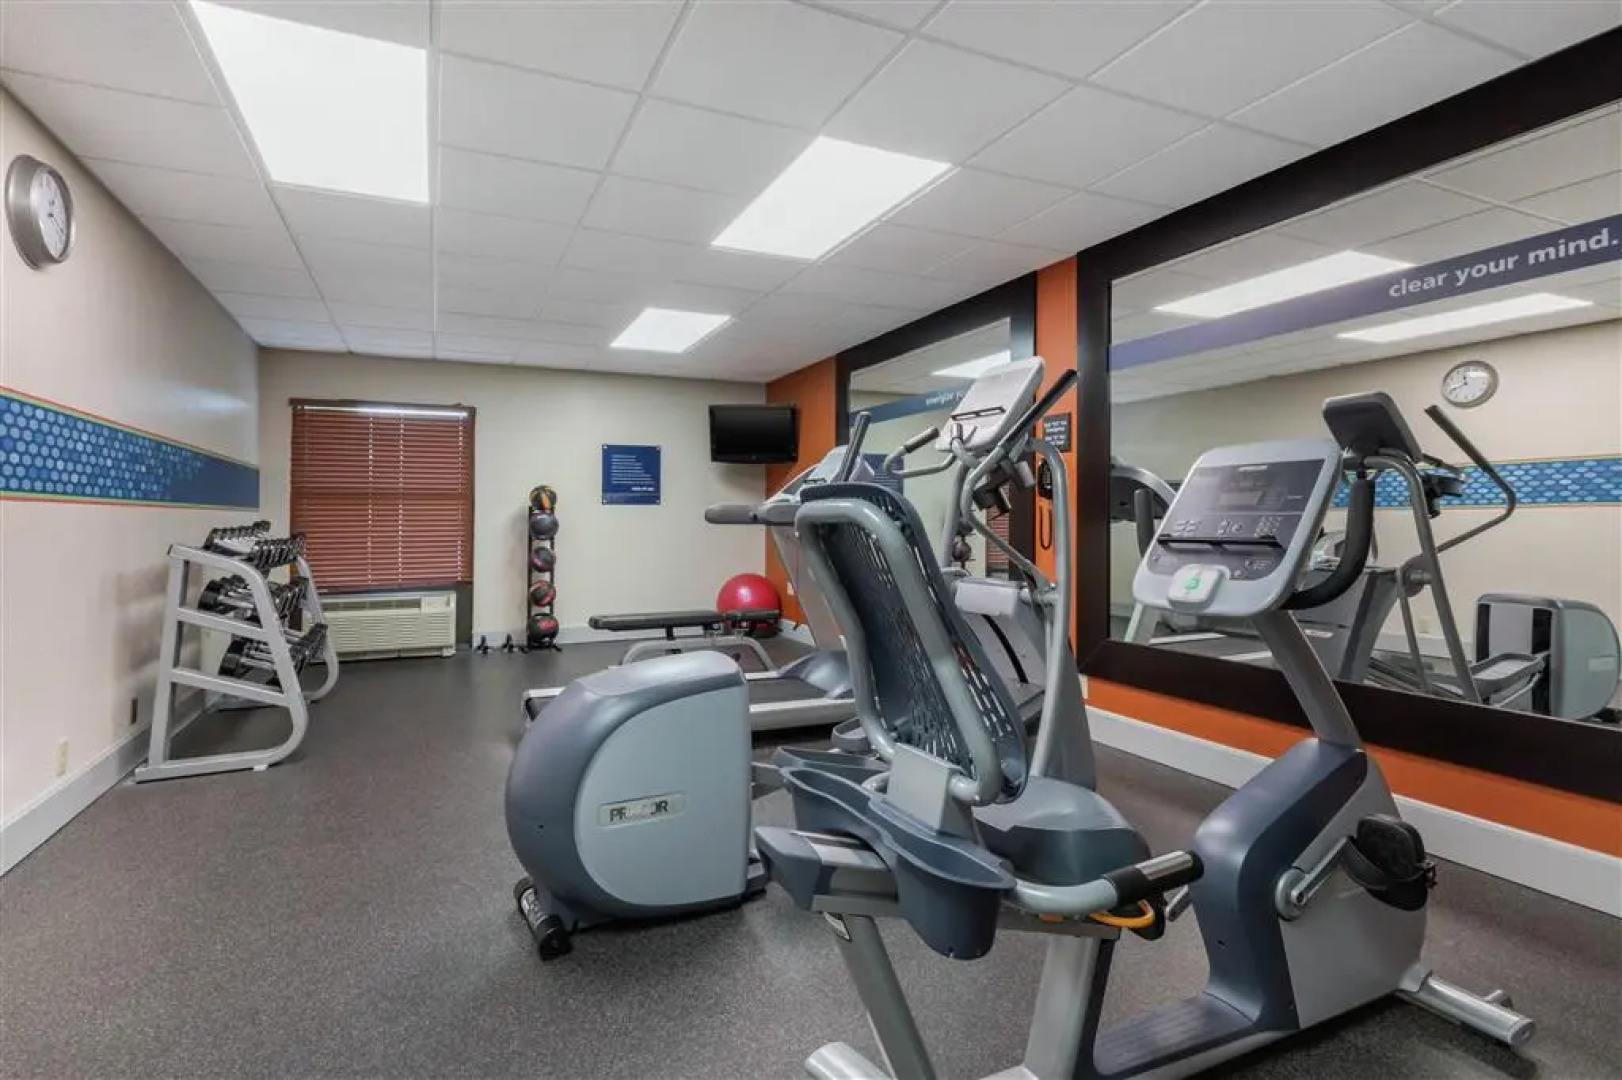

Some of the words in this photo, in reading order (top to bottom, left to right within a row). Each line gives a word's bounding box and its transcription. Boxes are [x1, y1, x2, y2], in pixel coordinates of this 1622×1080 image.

[1389, 272, 1448, 297] clear
[1456, 254, 1519, 286] your
[1528, 228, 1618, 264] mind.
